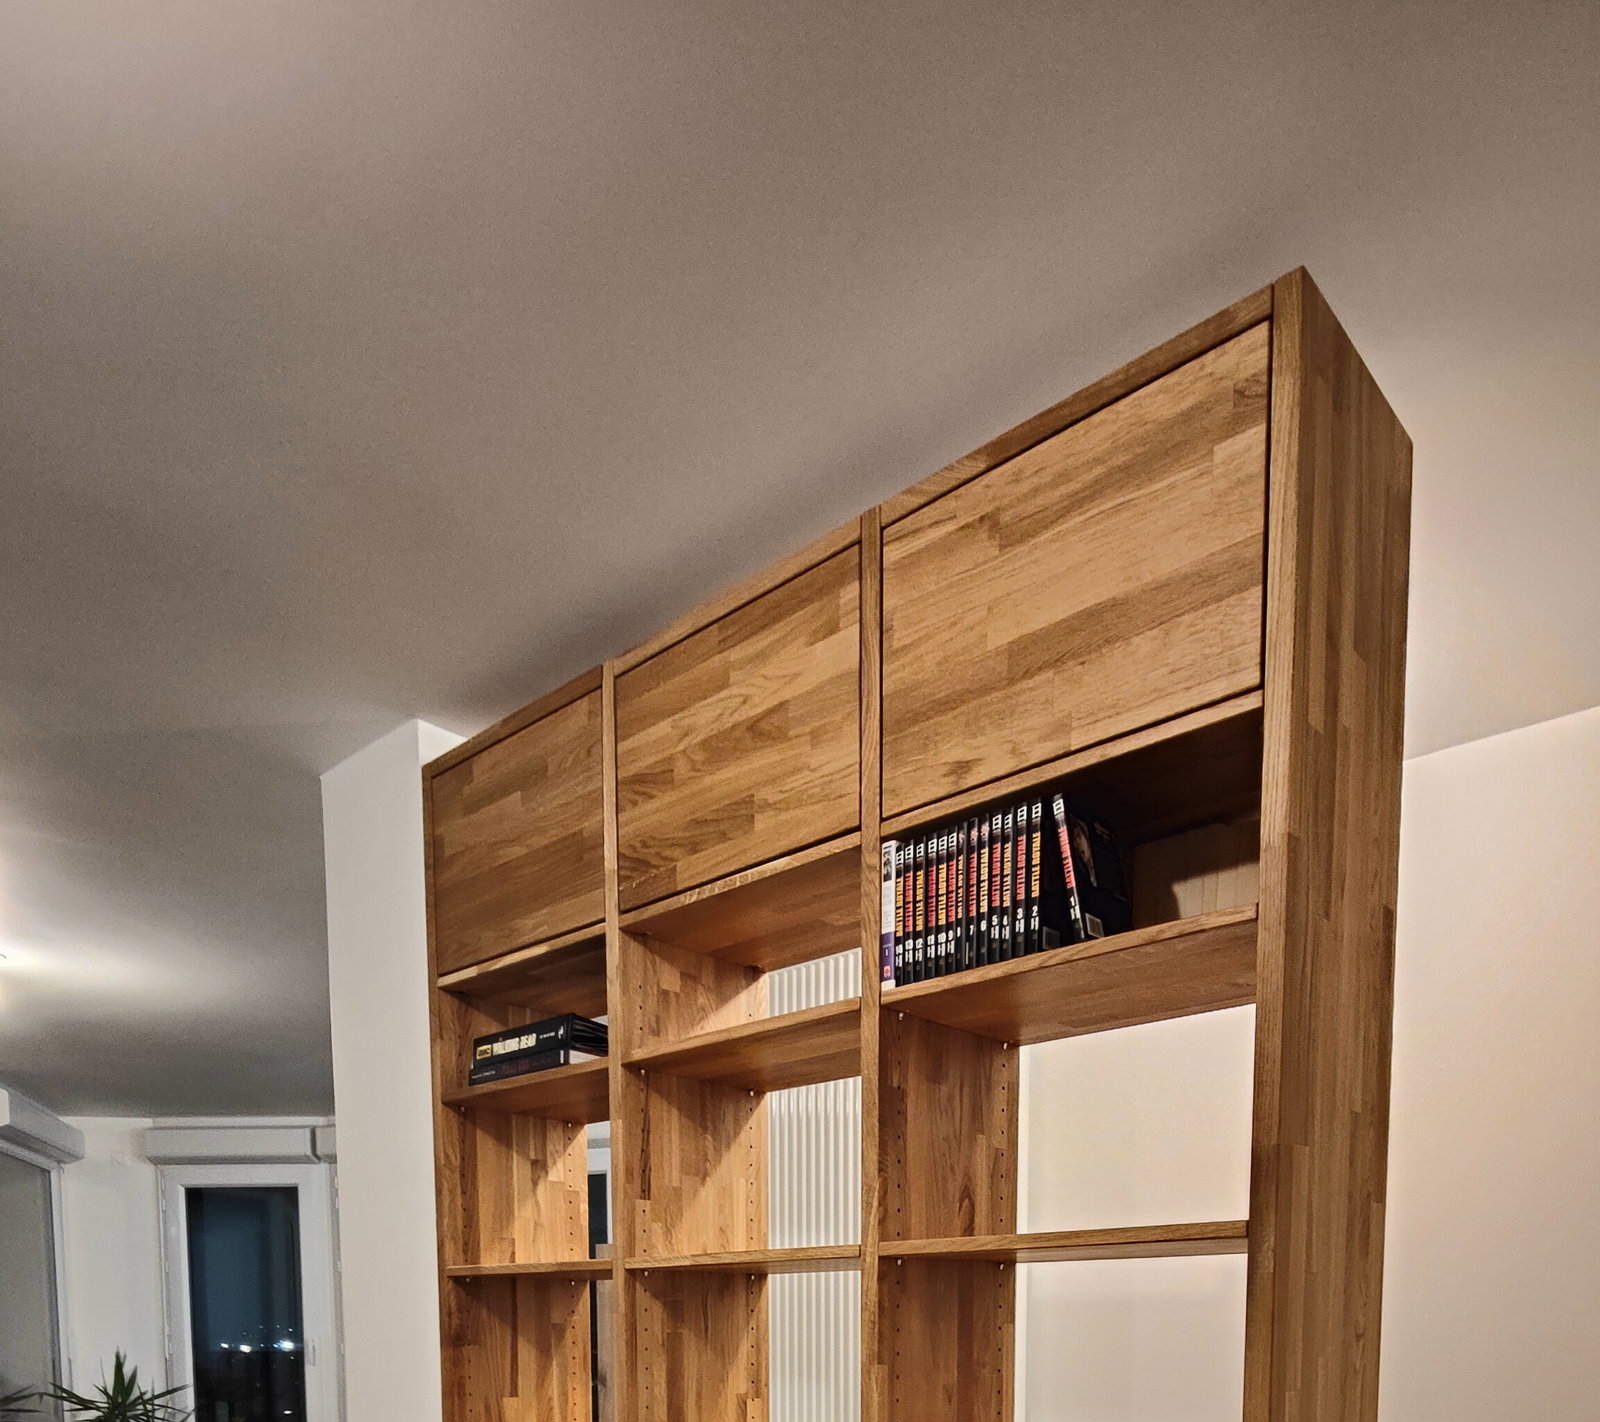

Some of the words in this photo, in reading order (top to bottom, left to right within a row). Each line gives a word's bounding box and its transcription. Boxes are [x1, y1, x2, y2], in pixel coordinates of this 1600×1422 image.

[1058, 826, 1070, 857] ROYALE
[1018, 835, 1026, 867] ROYALE
[1062, 857, 1075, 889] BATTLE
[1017, 868, 1025, 900] BATTLE
[1032, 866, 1040, 897] BATTLE
[992, 875, 1000, 907] BATTLE
[1003, 875, 1011, 907] BATTLE
[980, 881, 988, 912] BATTLE
[1070, 896, 1074, 906] 1
[938, 895, 946, 925] BATTLE
[1017, 908, 1023, 919] 3
[1033, 906, 1037, 916] 2
[992, 915, 997, 925] 5
[1003, 915, 1008, 925] 4
[970, 925, 974, 935] 7
[981, 921, 986, 931] 6
[928, 935, 934, 945] 11
[938, 933, 946, 943] 10
[948, 931, 953, 940] 9
[916, 938, 922, 948] 12
